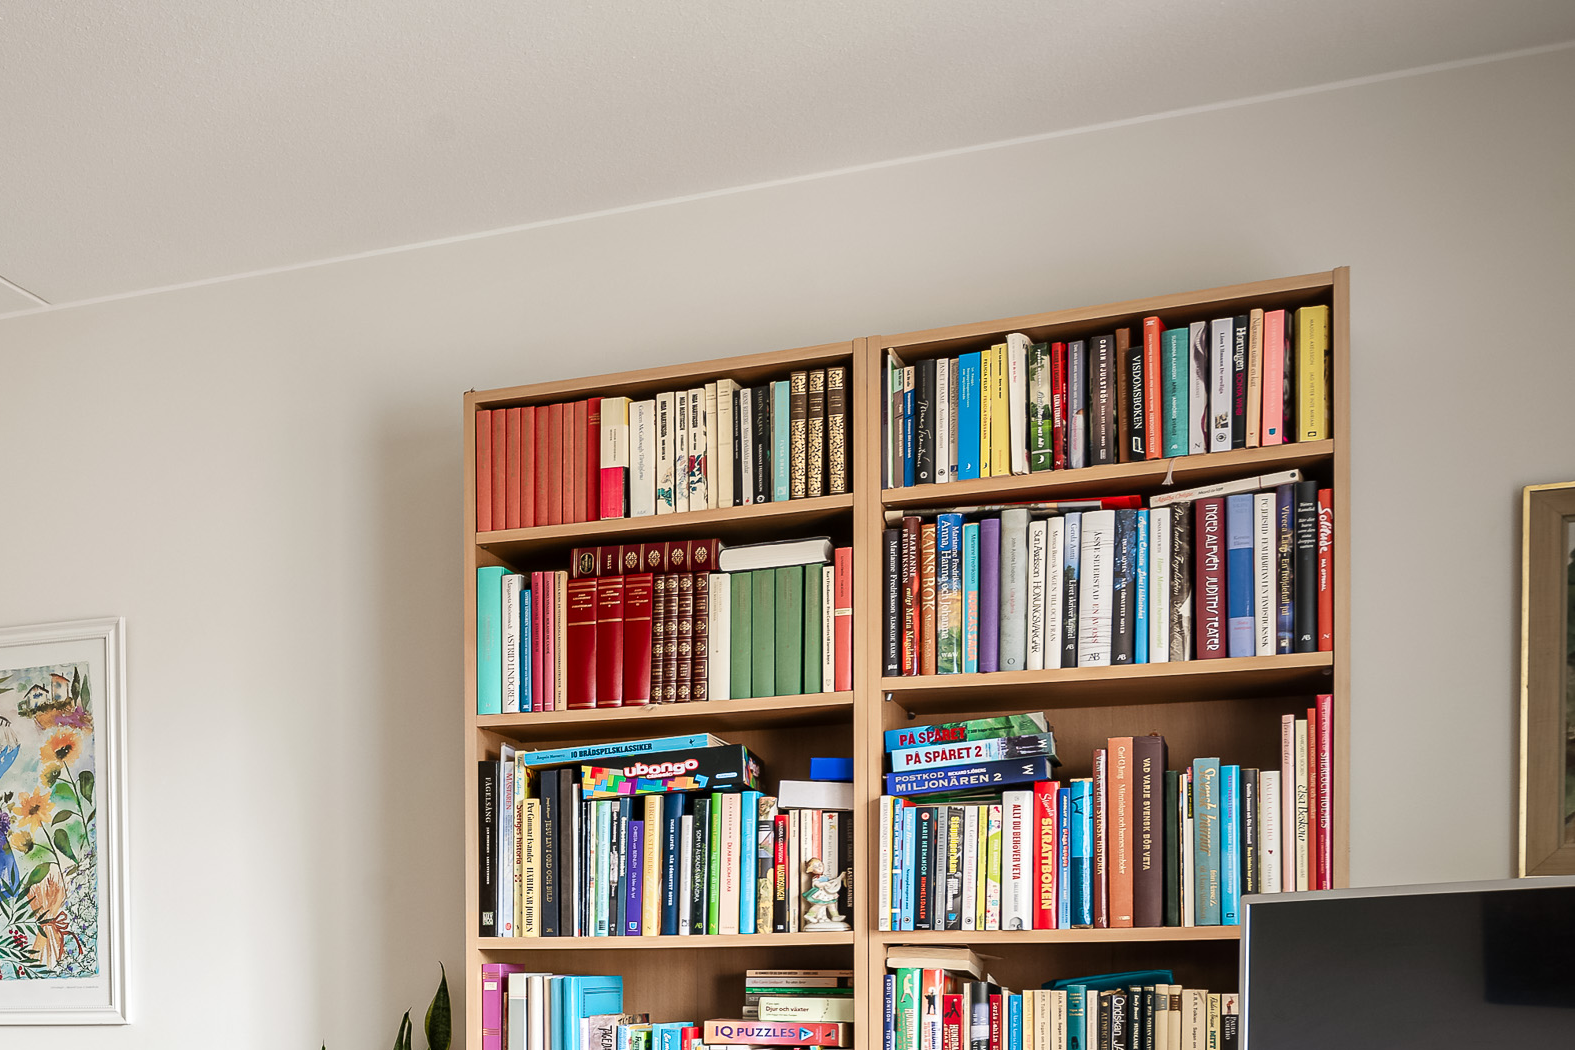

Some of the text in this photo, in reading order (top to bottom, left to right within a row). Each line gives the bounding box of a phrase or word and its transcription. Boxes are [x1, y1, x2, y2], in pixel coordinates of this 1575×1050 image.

[1099, 339, 1108, 404] CARIN HJULSTRÖM
[1233, 326, 1246, 371] Horungen
[1132, 355, 1142, 429] VISDOMSBOKEN
[890, 540, 898, 572] Marianne
[1138, 516, 1147, 566] Agatha Christie
[1172, 505, 1183, 596] Per Anders Fogelström
[1318, 501, 1333, 554] Solitude
[922, 526, 935, 611] KAINS BOK
[940, 520, 951, 639] Anna, Hanna och Johanna
[952, 526, 960, 596] Marianne Fredriksson
[1205, 504, 1220, 651] INGER ALFVÉN JUDITHS TEATER
[890, 574, 898, 613] Fredriksson
[1031, 530, 1042, 653] Sun Axelsson HONUNGSVARGAR
[1066, 579, 1078, 639] Livet skriver kapitel
[904, 588, 914, 669] enligt Maria Magdalena
[967, 590, 978, 661] NOREAS SAGA
[507, 633, 515, 706] ASTRID LINDGREN
[899, 727, 966, 746] PÅ SPÅRET
[905, 746, 982, 766] PÅ SPÅRET 2
[625, 760, 697, 777] ubongo
[895, 771, 945, 783] POSTKOD
[895, 773, 1003, 792] MILJONÄREN 2
[1319, 752, 1329, 828] SHERLOCK HOLMES
[514, 804, 523, 835] Sveriges
[1039, 794, 1054, 817] Största
[1143, 758, 1152, 870] VAD VARJE SVENSK BÖR VETA
[1199, 766, 1217, 856] Svensk humor
[1298, 784, 1308, 842] Elsa Beskow
[647, 801, 655, 874] BIRGITTA STENBERG
[1041, 818, 1052, 910] SKRATTBOKEN
[598, 1025, 613, 1040] TAGE
[715, 1025, 796, 1038] IQ PUZZLES
[1100, 1012, 1108, 1039] ALDRIG
[1113, 997, 1125, 1036] Ondskan
